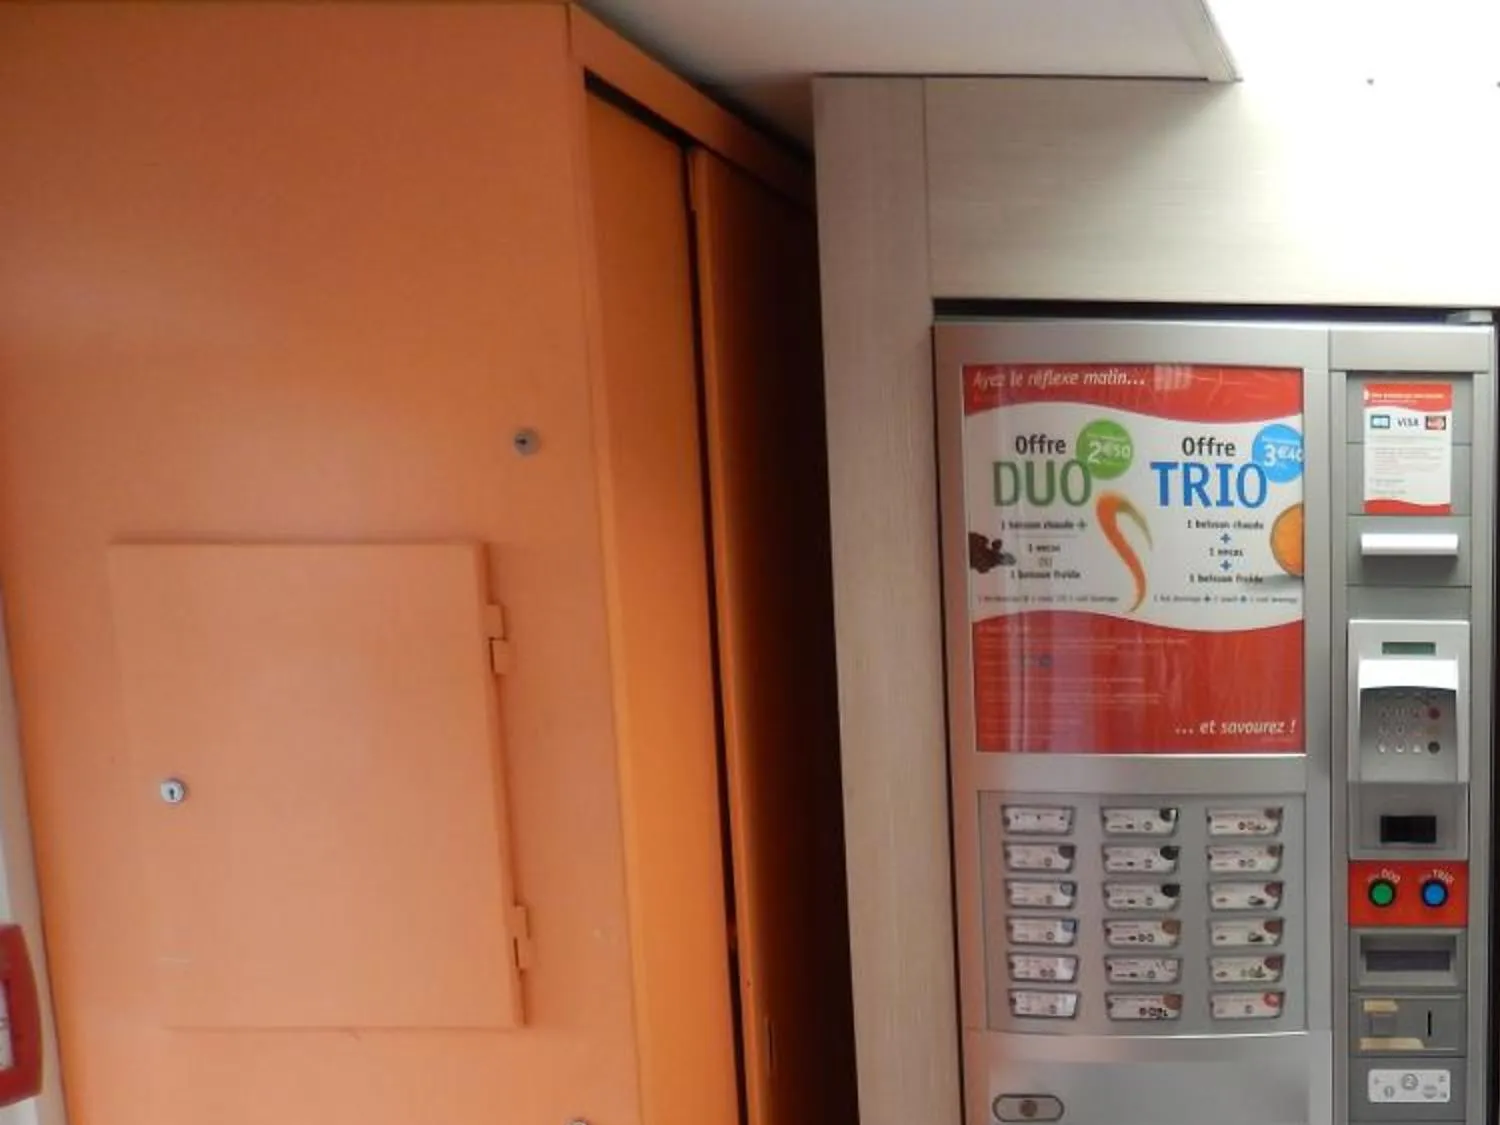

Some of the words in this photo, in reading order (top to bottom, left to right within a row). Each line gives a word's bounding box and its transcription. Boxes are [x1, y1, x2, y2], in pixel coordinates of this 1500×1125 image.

[1010, 369, 1024, 388] le
[1015, 434, 1067, 456] Offre
[1181, 435, 1237, 458] Offre
[992, 459, 1093, 509] DUO
[1149, 461, 1268, 509] TRIO
[1199, 719, 1216, 735] et
[1221, 720, 1286, 735] savourez
